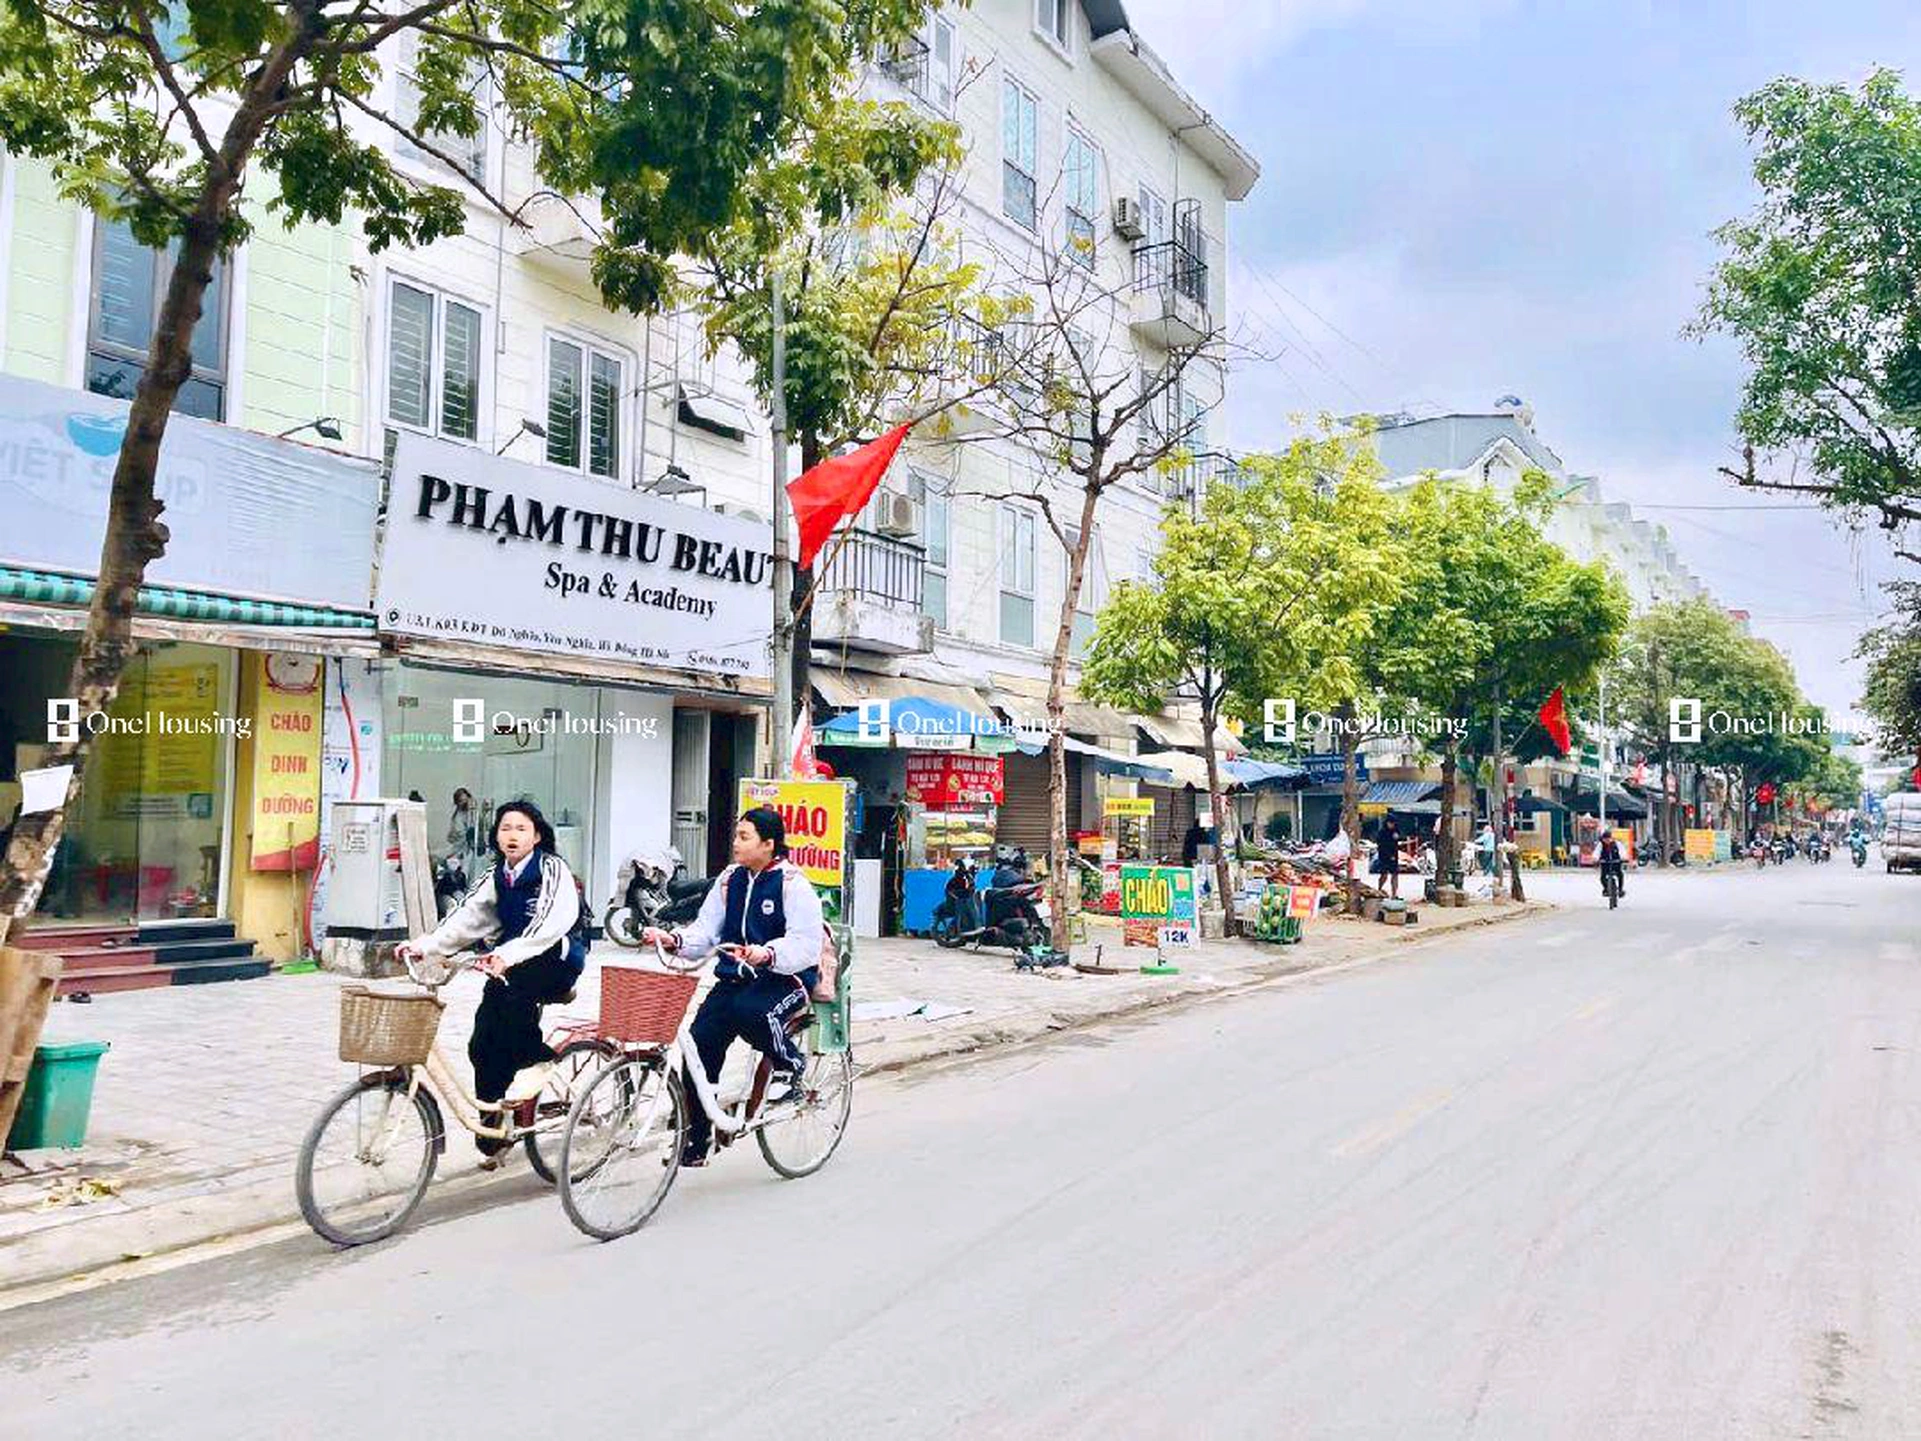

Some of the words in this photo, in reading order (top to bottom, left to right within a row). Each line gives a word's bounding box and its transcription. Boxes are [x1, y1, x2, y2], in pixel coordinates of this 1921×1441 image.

[417, 474, 570, 545] PHẠM
[574, 509, 667, 564] THU
[545, 562, 590, 597] Spa
[598, 572, 618, 598] &
[624, 577, 718, 619] Academy
[271, 711, 312, 732] CHÁO
[270, 754, 307, 774] DINH
[763, 799, 828, 838] HÁO
[1164, 930, 1190, 944] 12K
